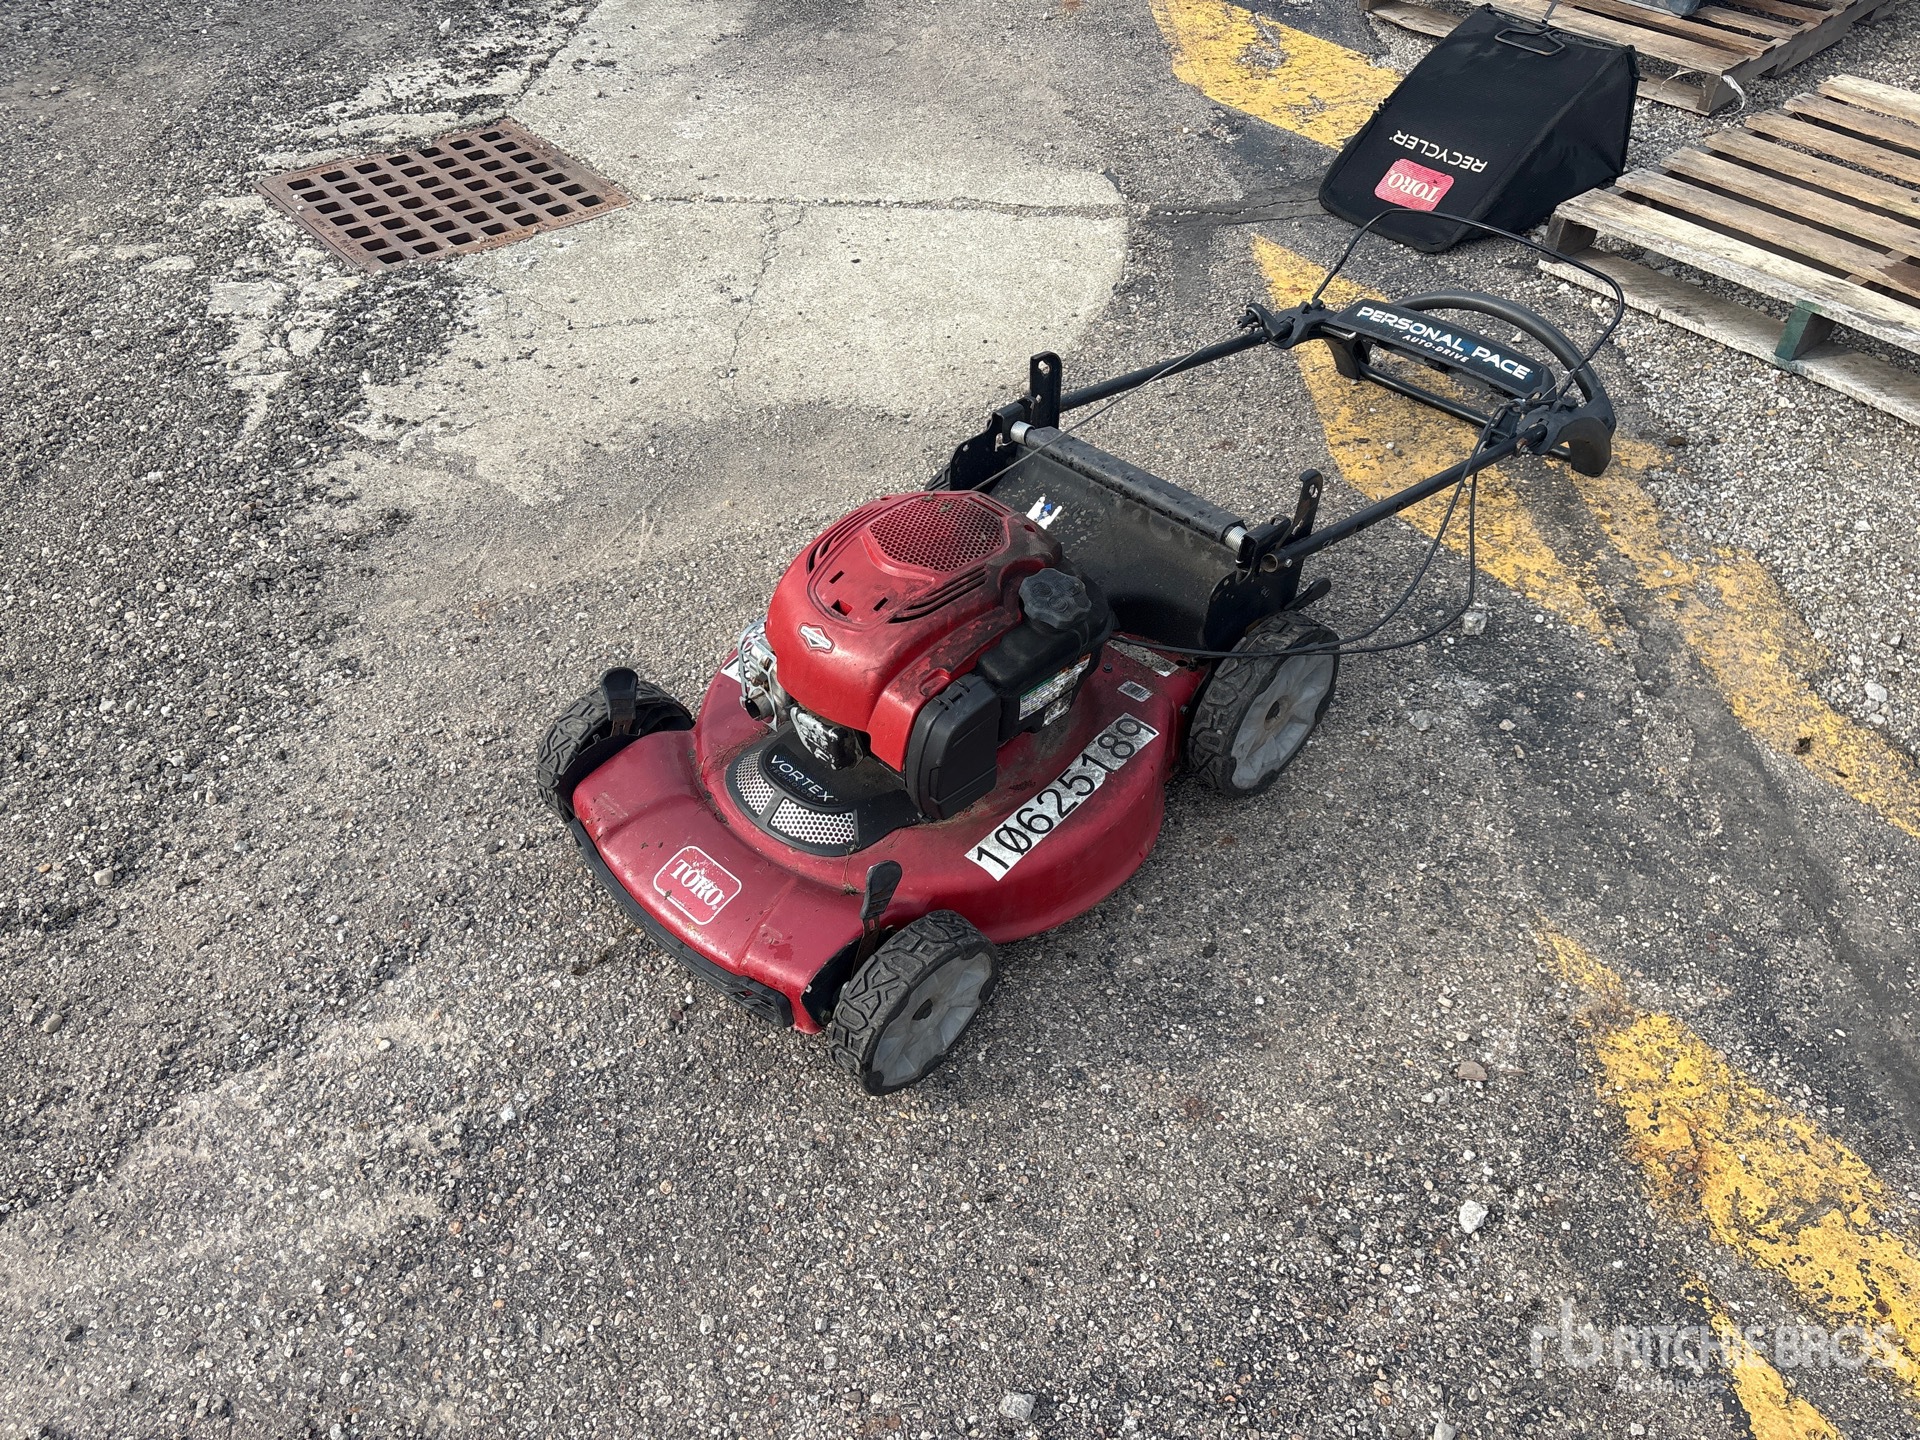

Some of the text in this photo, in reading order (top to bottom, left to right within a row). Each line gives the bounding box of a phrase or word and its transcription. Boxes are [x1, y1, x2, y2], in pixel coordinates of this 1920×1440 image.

[1391, 129, 1488, 173] RECYCLER
[1387, 173, 1441, 203] TORO
[1356, 306, 1532, 381] PERSONAL PACE
[1402, 334, 1470, 363] AUTO-DRIVE
[771, 754, 835, 802] VORTEX
[976, 717, 1158, 870] 10625189
[669, 859, 726, 907] TORO
